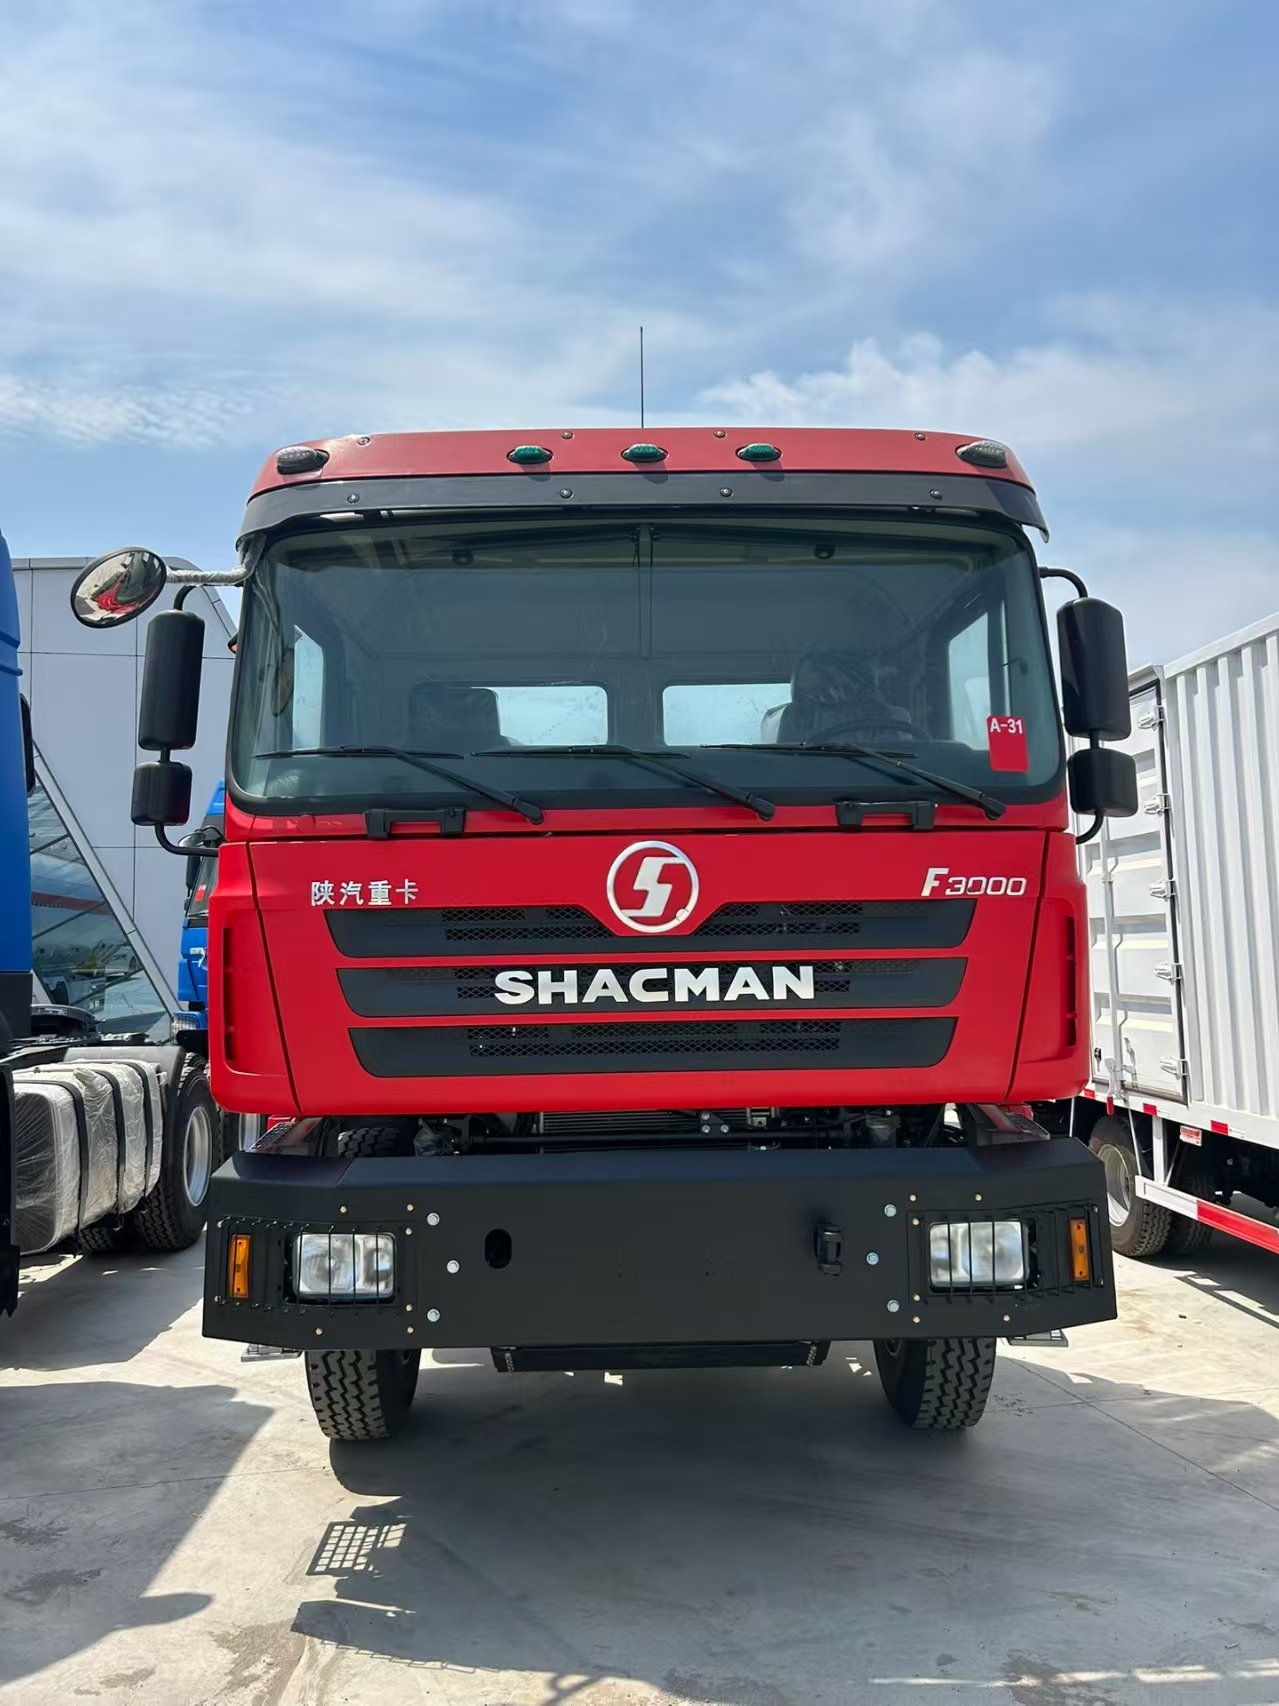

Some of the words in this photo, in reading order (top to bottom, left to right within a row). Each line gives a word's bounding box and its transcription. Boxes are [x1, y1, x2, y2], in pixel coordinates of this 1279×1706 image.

[990, 717, 1023, 734] A-31
[311, 879, 419, 906] 陕汽重卡
[921, 867, 1027, 896] F3000
[494, 965, 815, 1005] SHACMAN
